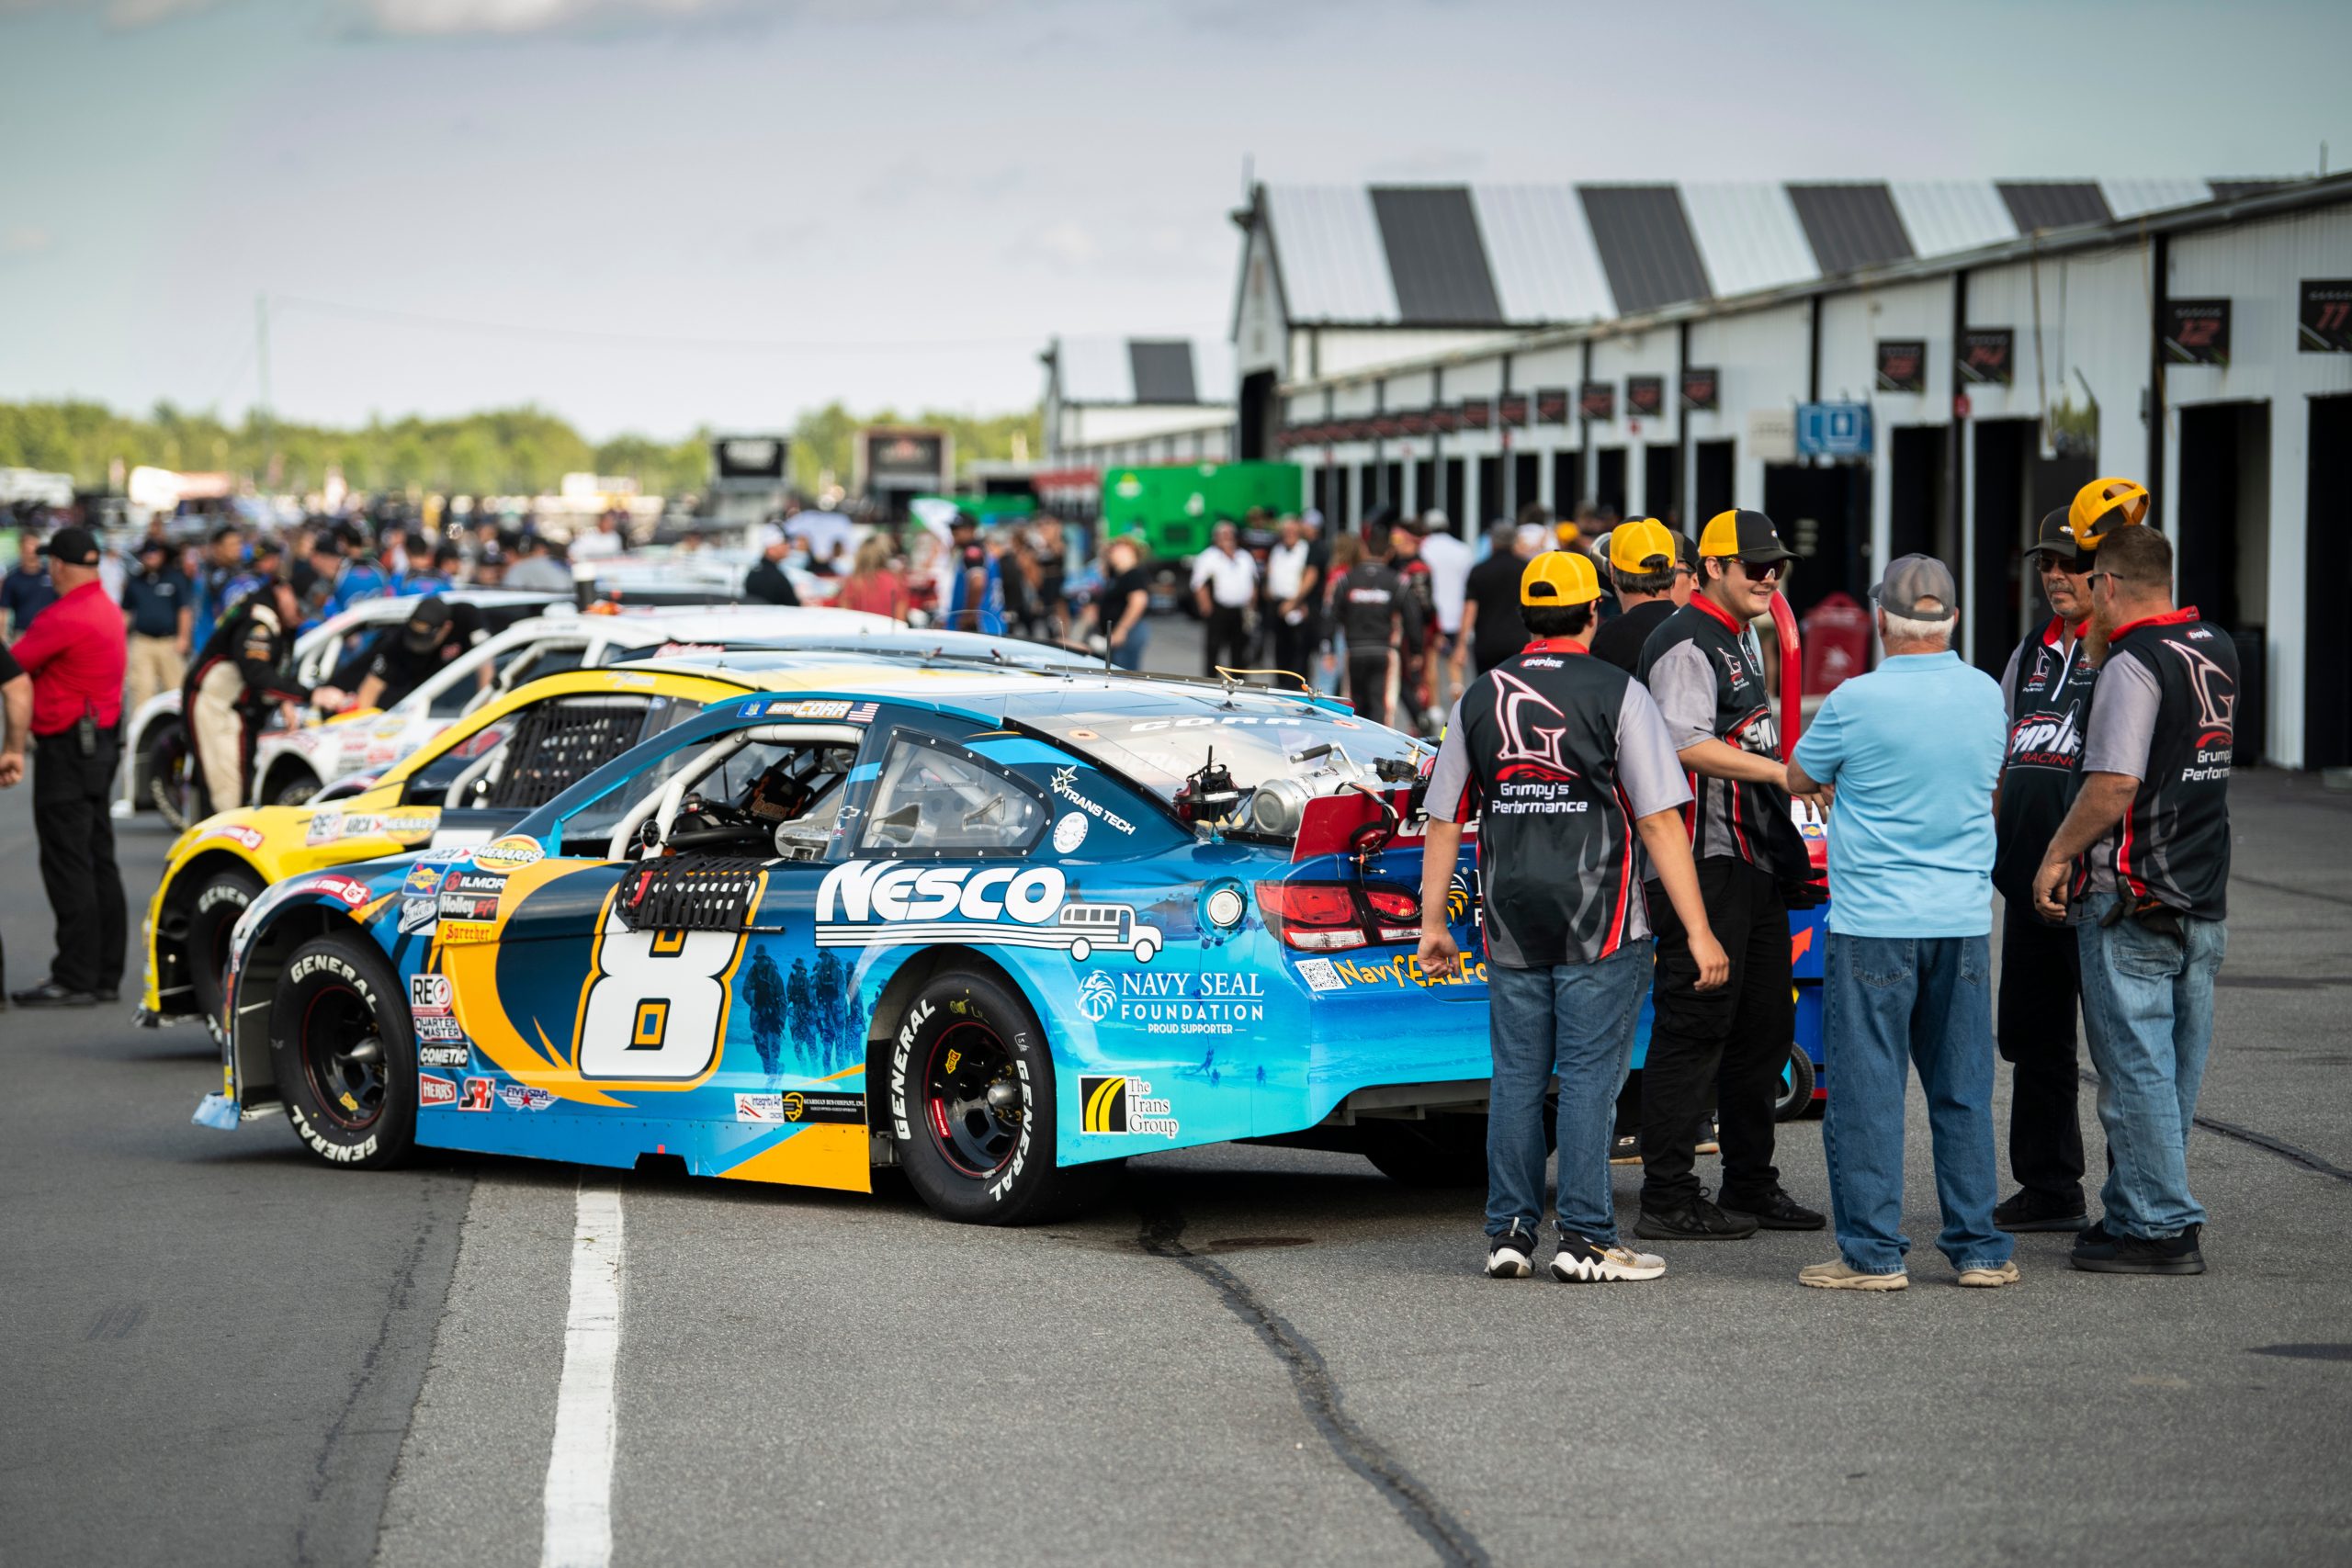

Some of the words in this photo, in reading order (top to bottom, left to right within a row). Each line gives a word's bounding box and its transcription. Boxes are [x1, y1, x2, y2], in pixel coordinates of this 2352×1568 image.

[1063, 788, 1104, 818] TRANS
[1102, 809, 1137, 836] TECH
[472, 846, 545, 863] MENARDS
[459, 875, 507, 890] ILMOR
[815, 859, 1068, 924] NESCO
[439, 894, 476, 919] Holley
[445, 922, 491, 942] Sprecher
[289, 953, 379, 1014] GENERAL
[571, 869, 768, 1091] 8
[1121, 972, 1192, 997] NAVY
[1200, 972, 1265, 998] SEAL
[1121, 1004, 1264, 1021] FOUNDATION
[415, 1017, 457, 1032] QUARTER
[423, 1027, 459, 1038] MASTER
[1148, 1022, 1180, 1034] PROUD
[1180, 1022, 1234, 1035] SUPPORTER
[420, 1048, 469, 1065] COMETIC
[890, 998, 936, 1141] GENERAL
[506, 1086, 526, 1098] FIVE
[527, 1089, 549, 1100] STAR
[1128, 1078, 1150, 1093] The
[1128, 1094, 1170, 1112] Trans
[292, 1104, 379, 1163] GENERAL
[989, 1059, 1034, 1201] GENERAL
[1129, 1114, 1179, 1136] Group
